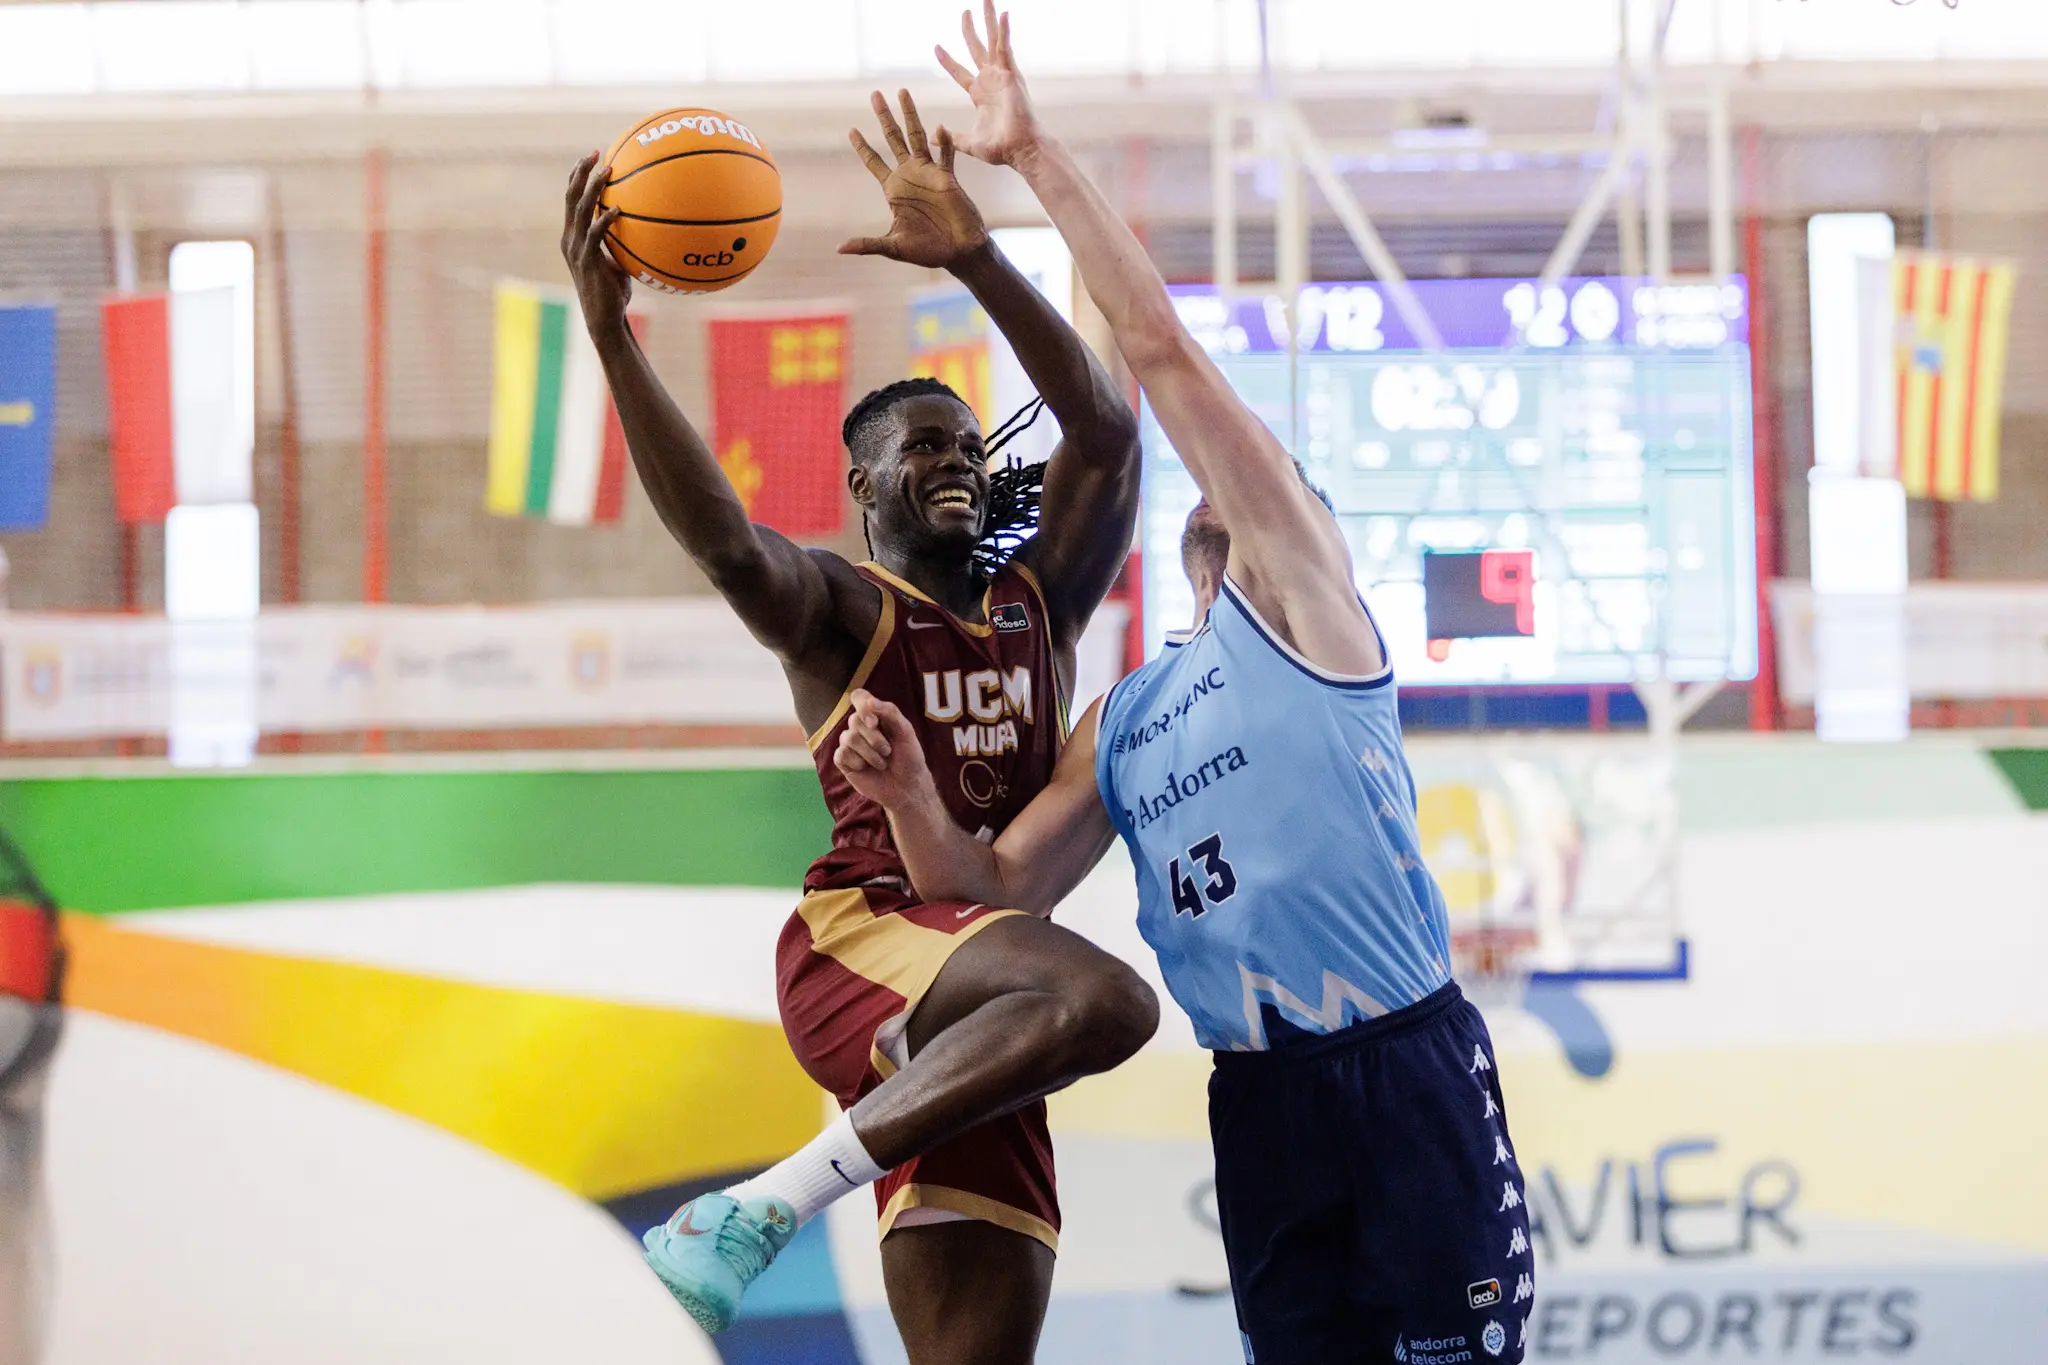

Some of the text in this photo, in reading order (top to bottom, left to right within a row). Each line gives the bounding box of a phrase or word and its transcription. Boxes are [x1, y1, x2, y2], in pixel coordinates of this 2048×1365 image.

[636, 115, 762, 150] Wilson
[683, 250, 735, 267] acb
[1139, 745, 1249, 830] Andorra
[1167, 831, 1238, 921] 43
[1473, 1290, 1495, 1305] acb
[1536, 1286, 1923, 1359] EPORTES
[1410, 1336, 1467, 1351] andorra
[1411, 1350, 1472, 1365] telecom
